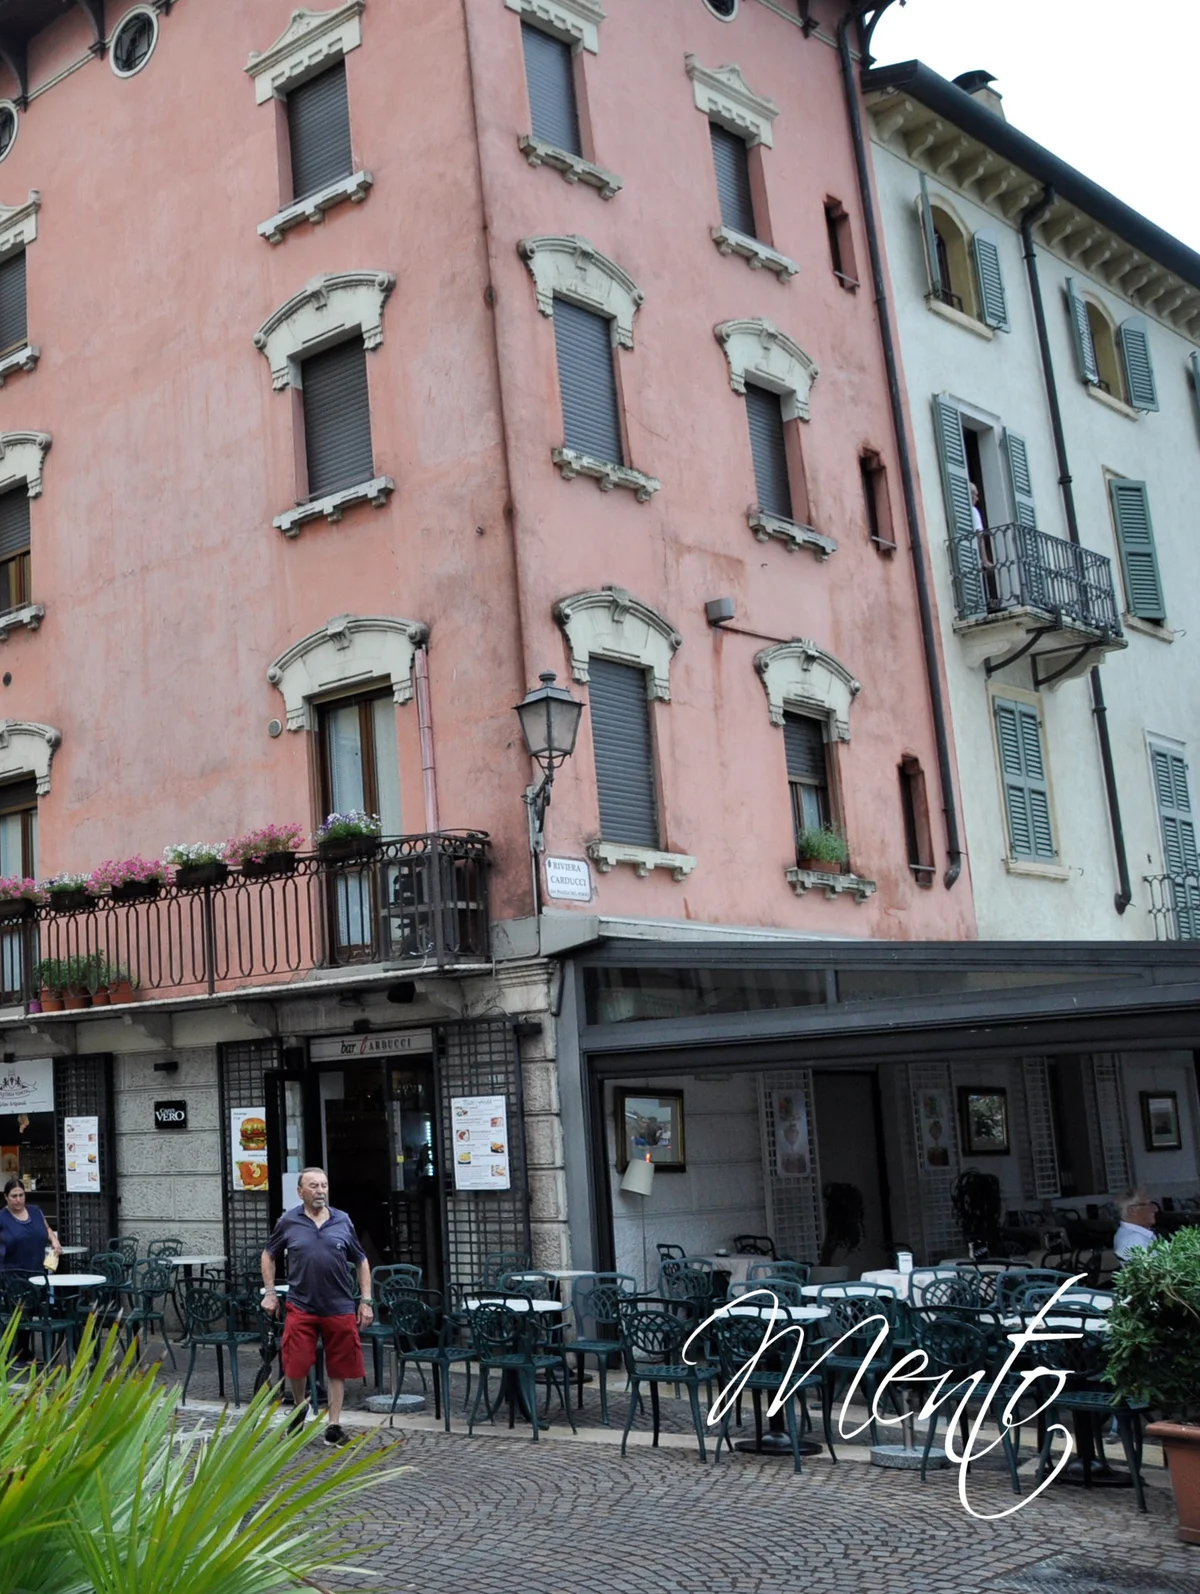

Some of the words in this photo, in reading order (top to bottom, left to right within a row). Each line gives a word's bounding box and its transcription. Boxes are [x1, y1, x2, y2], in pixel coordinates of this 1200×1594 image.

[553, 862, 581, 872] RIVIERA
[550, 875, 587, 886] CARDUCCI
[341, 1040, 356, 1054] bar
[155, 1110, 185, 1121] VERO
